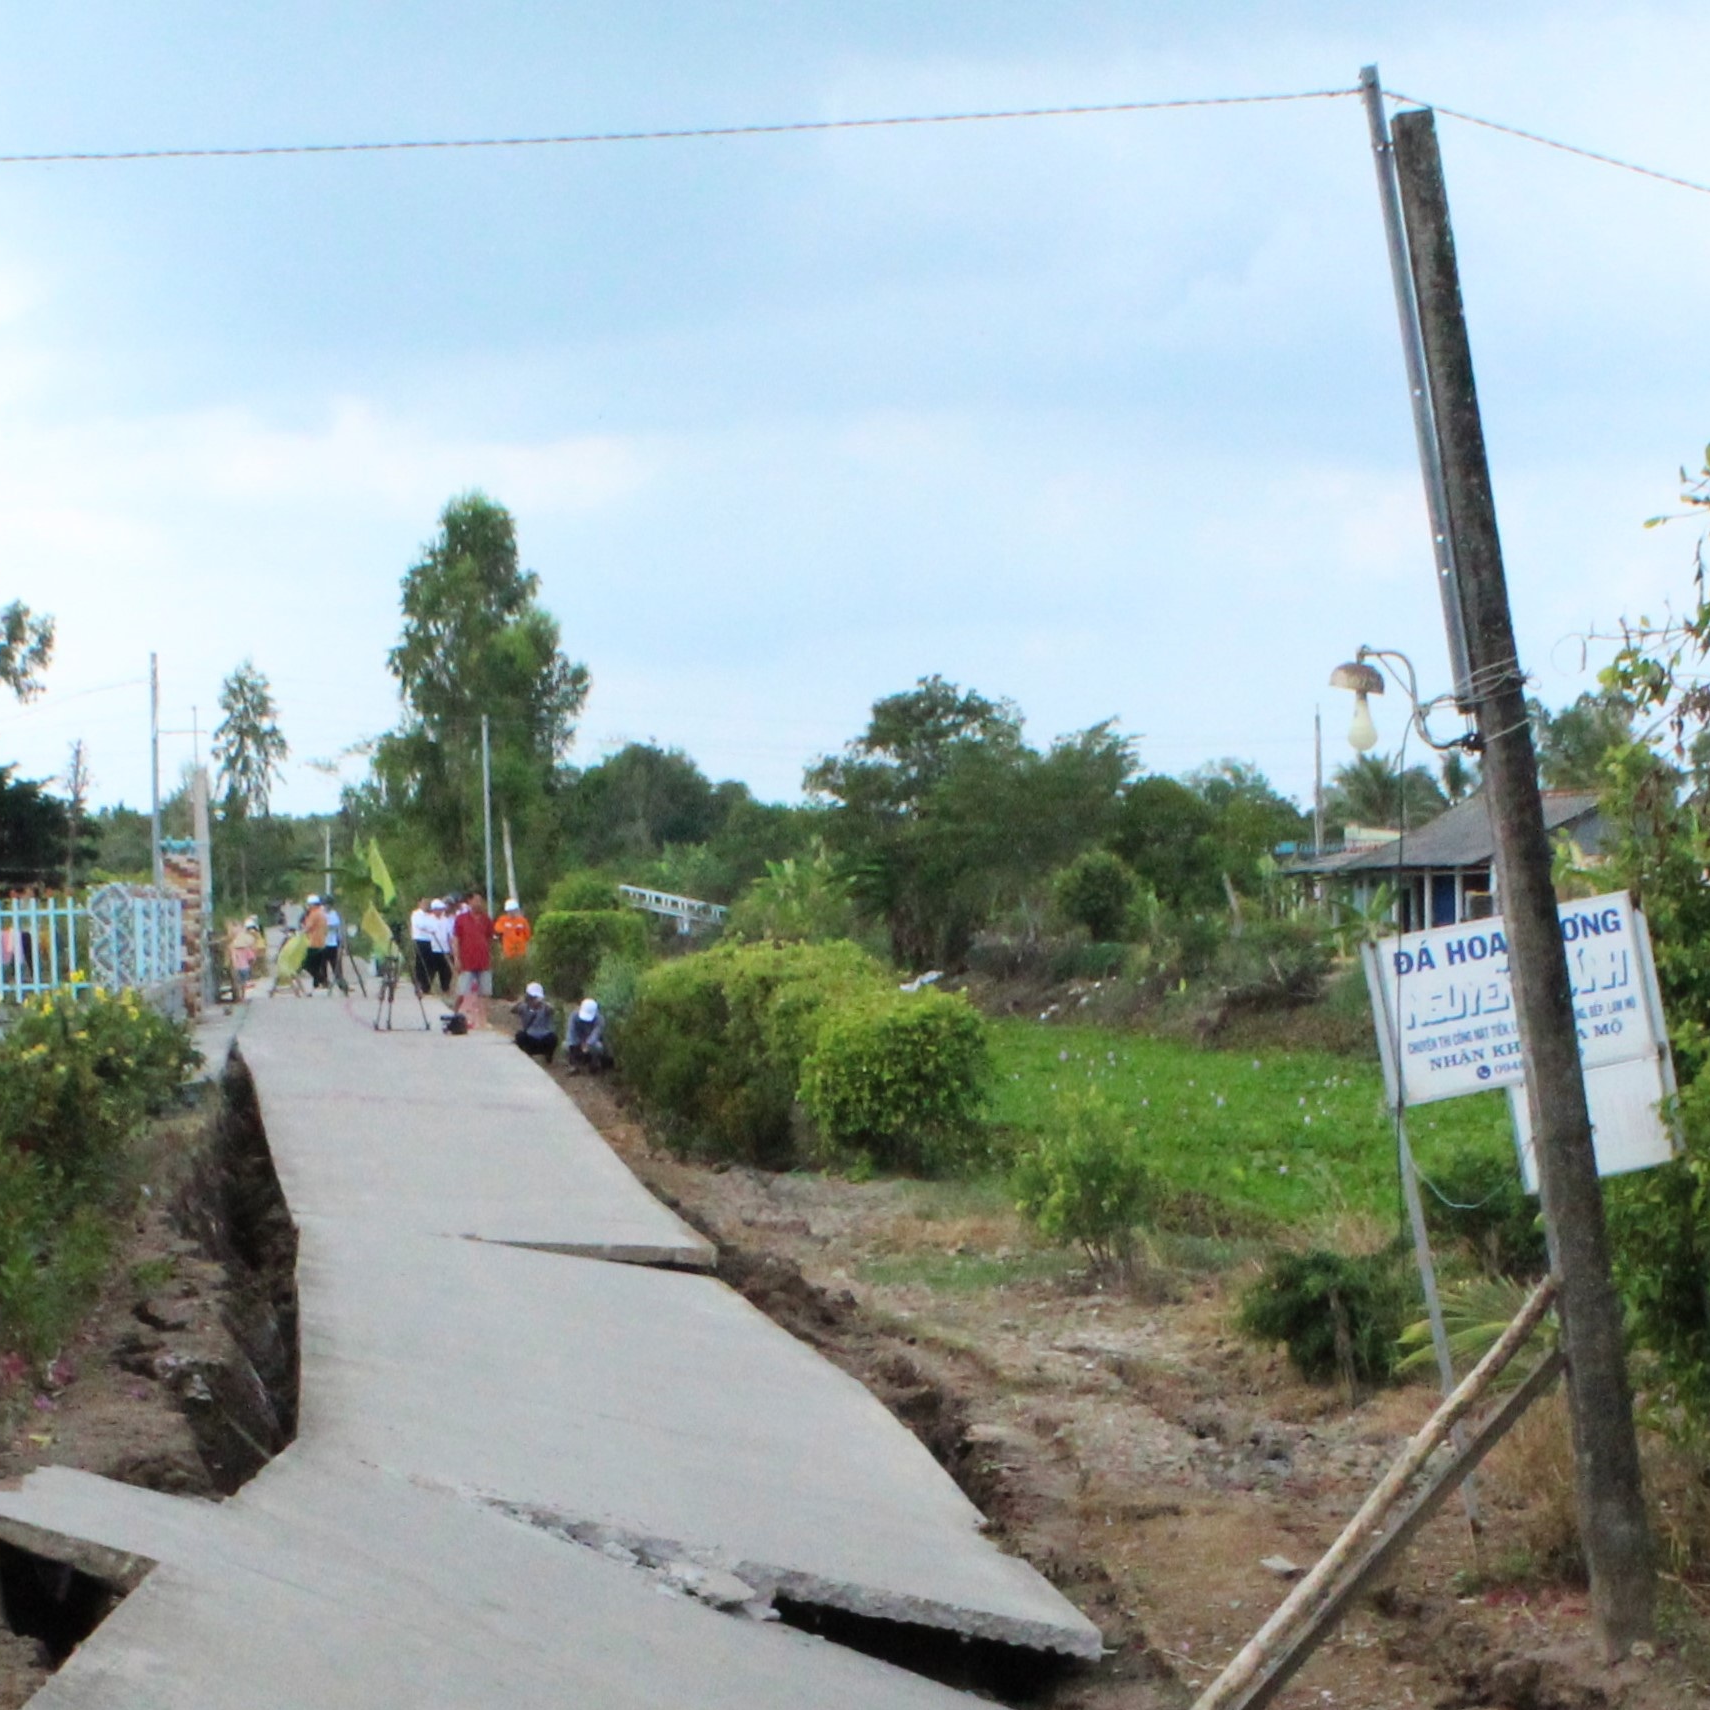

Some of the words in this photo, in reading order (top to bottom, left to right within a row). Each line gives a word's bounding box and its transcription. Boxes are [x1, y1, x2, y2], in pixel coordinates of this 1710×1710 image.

[1393, 939, 1436, 975] ĐÁ
[1446, 931, 1509, 966] HOA
[1429, 1046, 1486, 1072] NHẬN
[1593, 1017, 1623, 1038] MỘ
